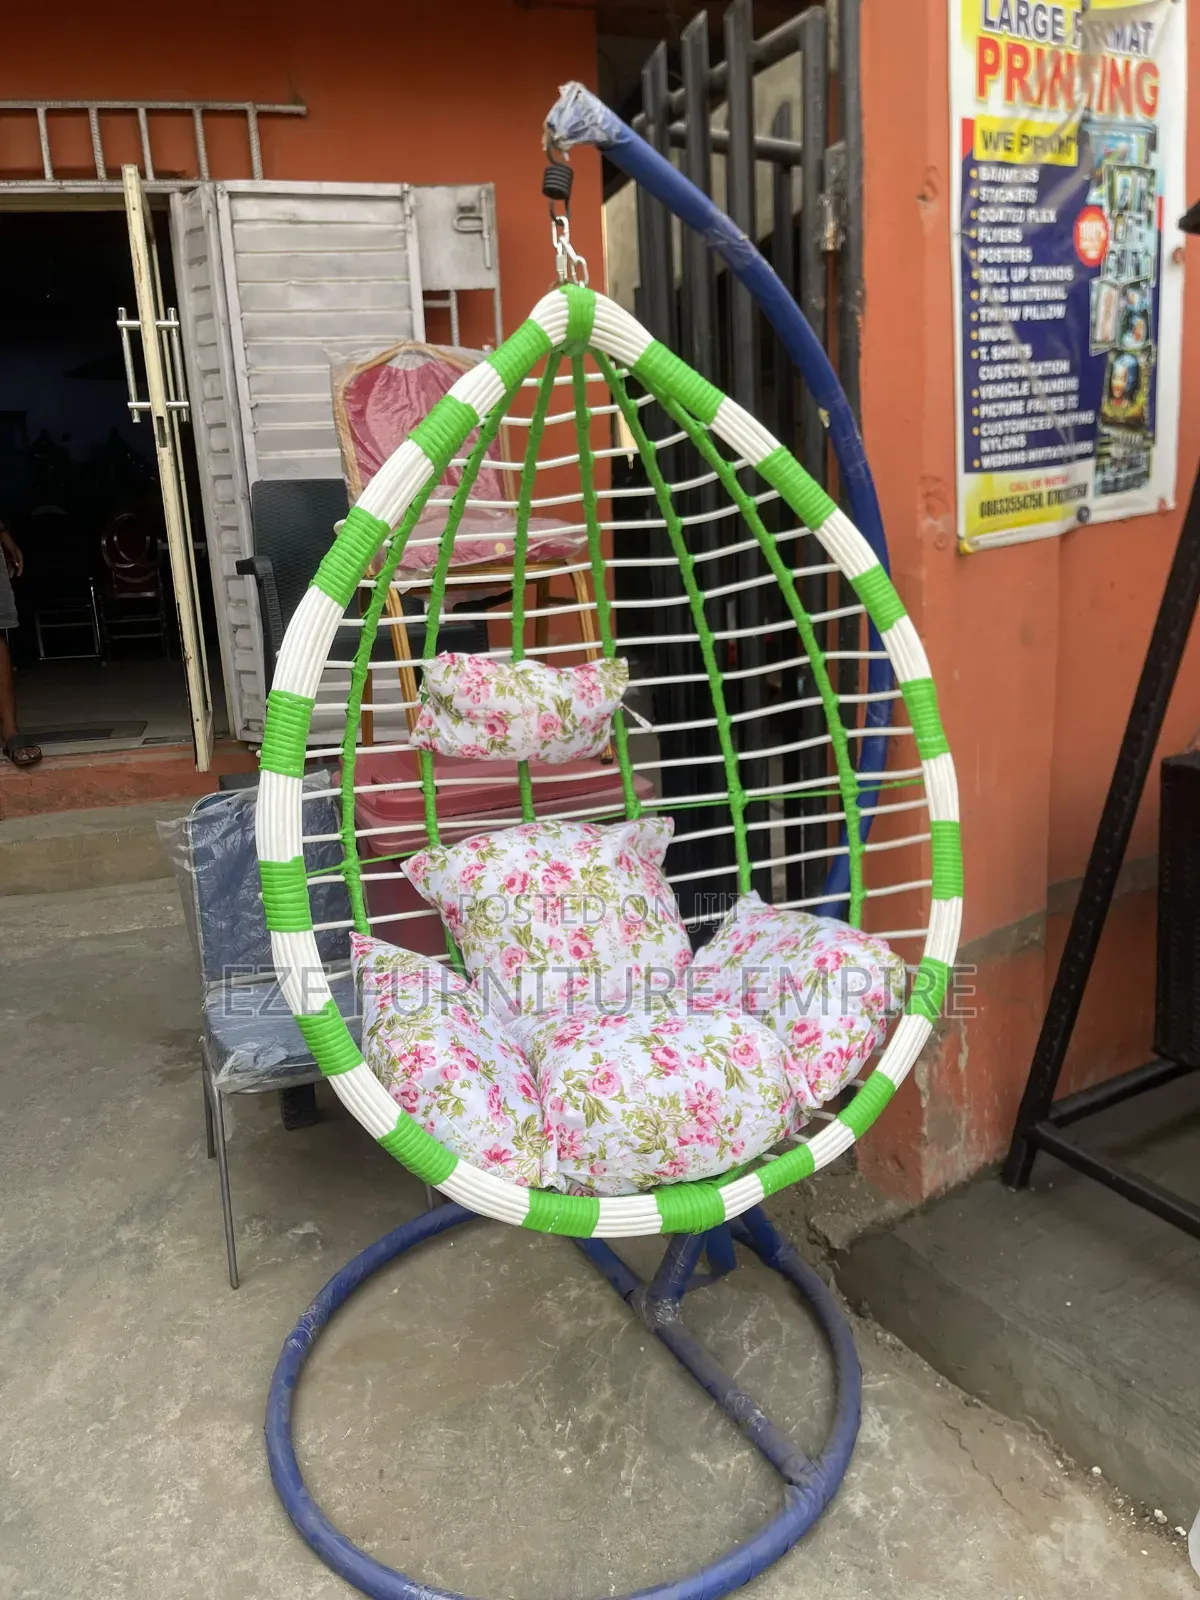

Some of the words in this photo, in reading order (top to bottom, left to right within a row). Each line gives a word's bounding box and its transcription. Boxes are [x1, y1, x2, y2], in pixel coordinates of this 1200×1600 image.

[983, 0, 1064, 44] LARGE
[1072, 10, 1155, 56] FRMAT
[982, 130, 1015, 153] WE
[978, 226, 1023, 244] FLYERS
[978, 246, 1033, 264] POSTERS
[1010, 266, 1029, 283] UP
[1022, 303, 1067, 322] PILLOW
[979, 380, 1030, 400] VEHICLE
[980, 400, 1026, 419] PICTURE
[980, 413, 1055, 438] CUSTOMIZED
[980, 433, 1027, 453] NYLONS
